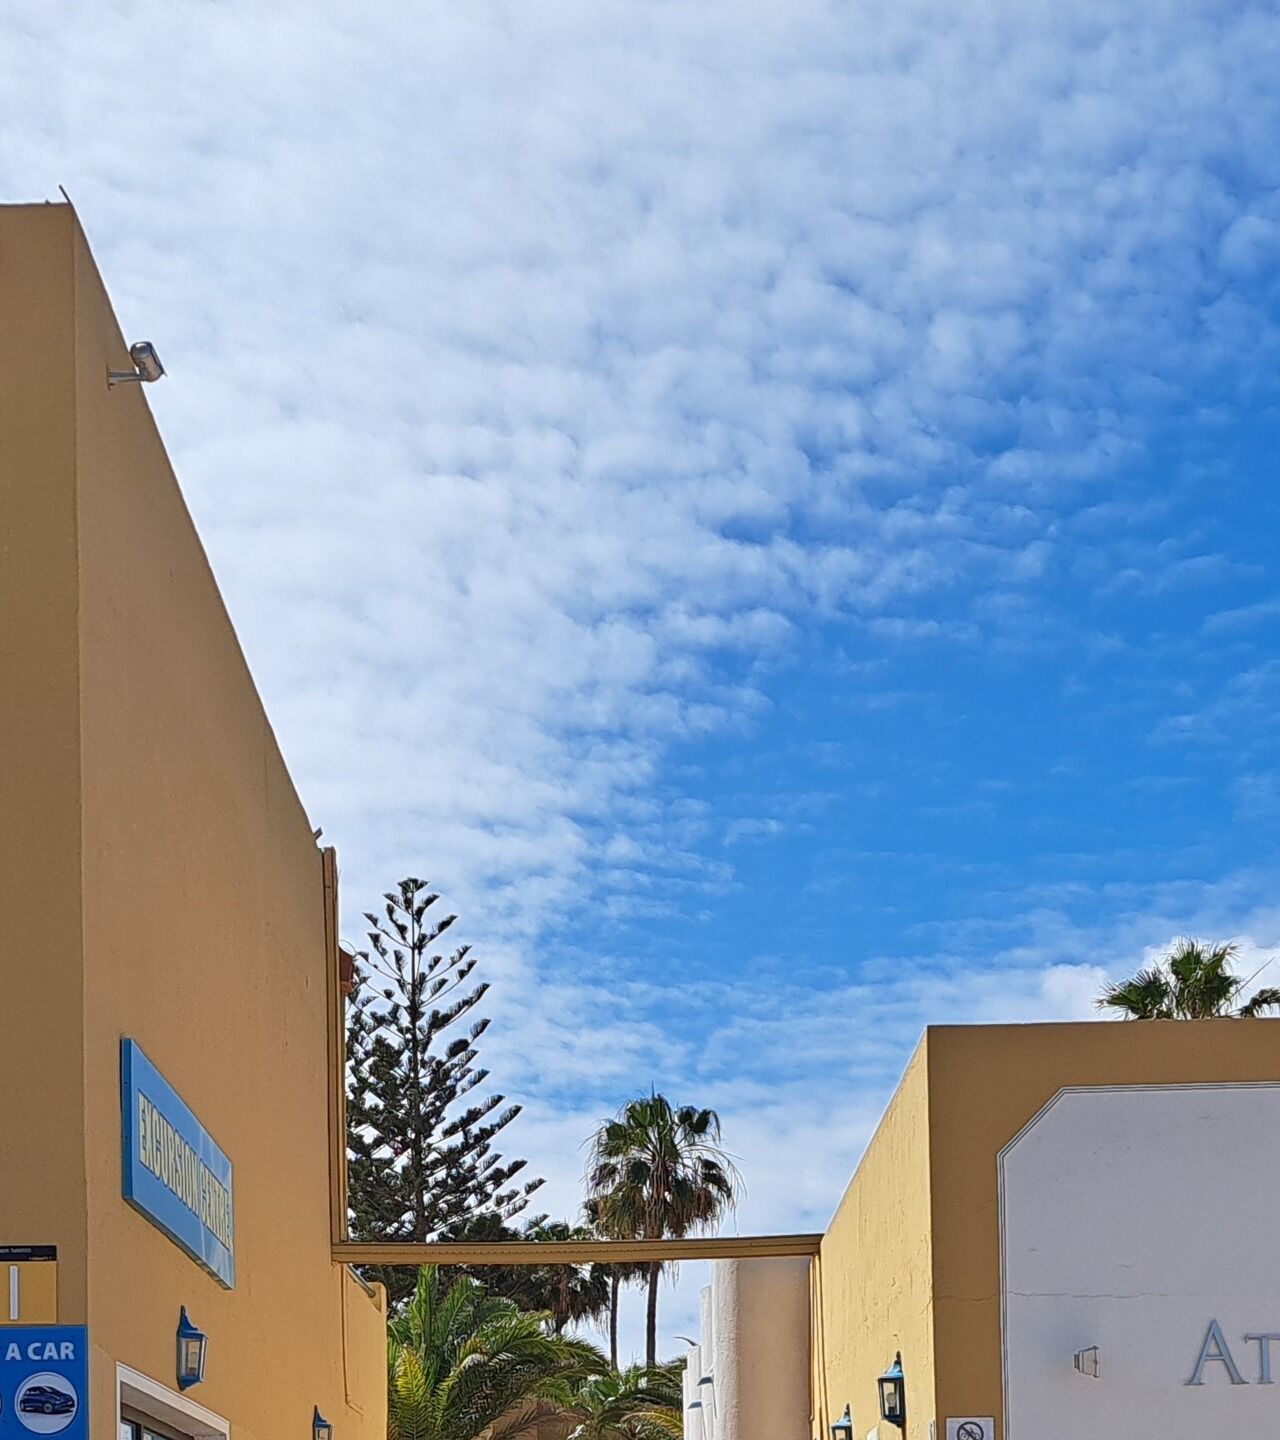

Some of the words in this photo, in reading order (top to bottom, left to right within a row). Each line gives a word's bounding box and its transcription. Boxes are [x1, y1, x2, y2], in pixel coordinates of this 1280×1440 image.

[138, 1088, 200, 1220] EXCURSION
[199, 1158, 232, 1251] CENTRE
[5, 1343, 22, 1360] A
[27, 1342, 75, 1360] CAR
